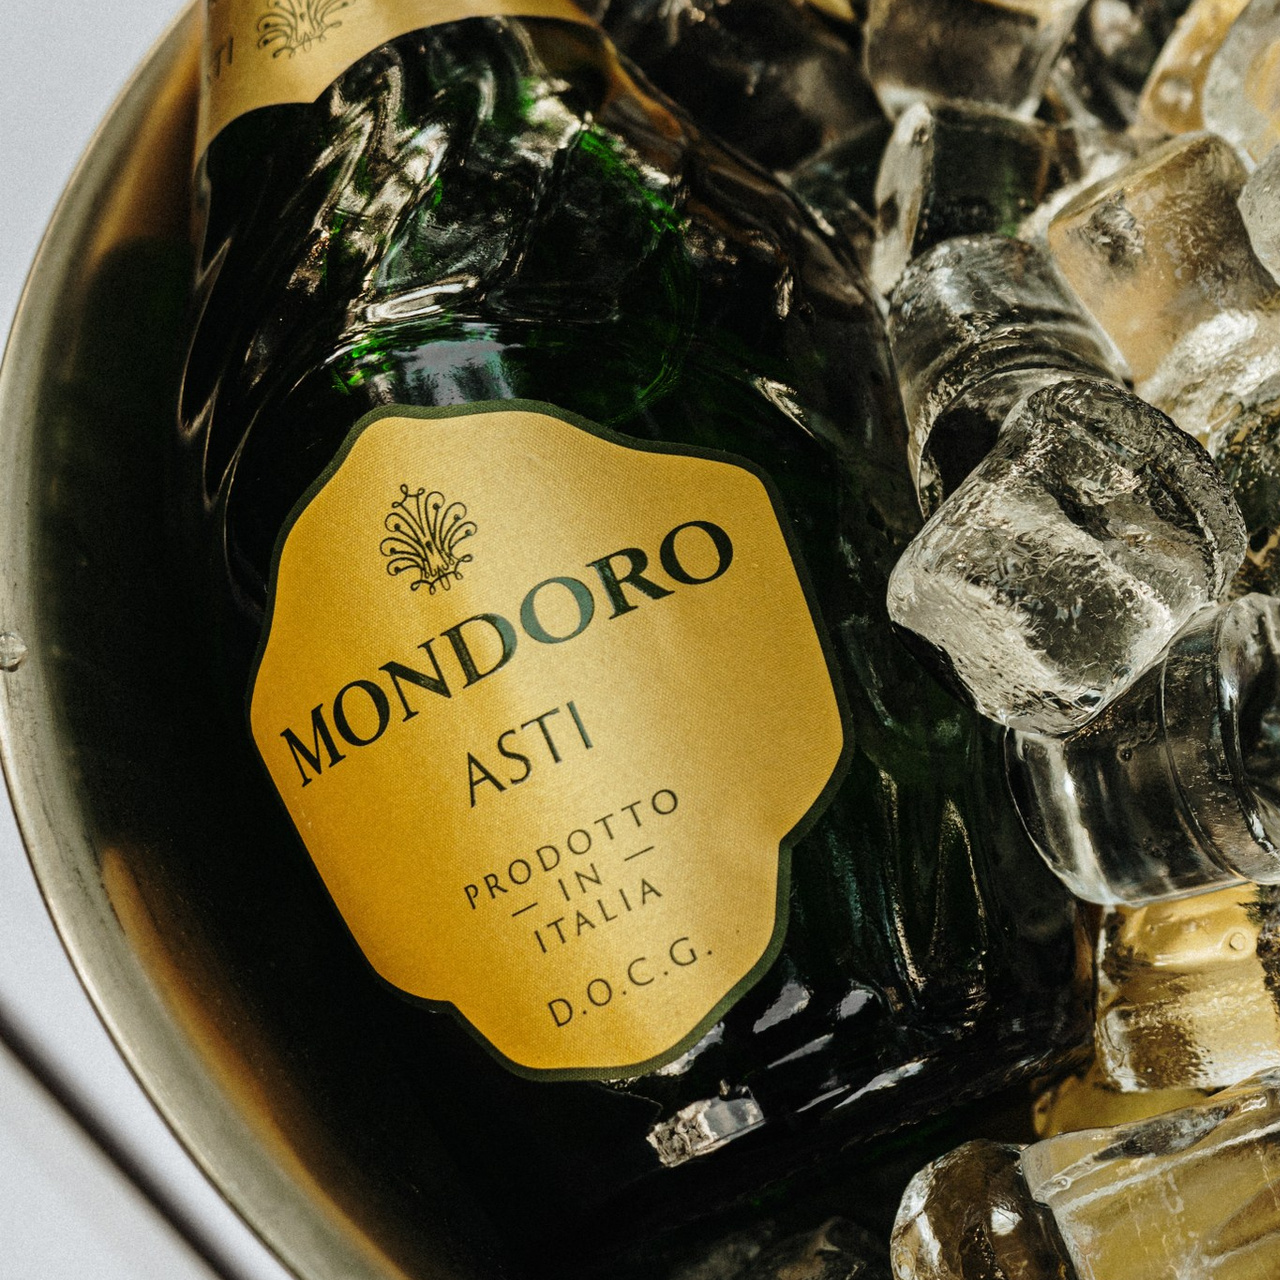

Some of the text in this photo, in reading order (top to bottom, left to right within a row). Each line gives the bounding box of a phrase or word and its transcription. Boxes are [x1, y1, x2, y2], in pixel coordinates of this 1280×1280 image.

[280, 521, 734, 787] MONDORO
[465, 700, 594, 807] ASTI
[463, 788, 680, 909] PRODOTTO
[534, 878, 663, 953] ITALIA
[547, 935, 713, 1027] D.O.C.G.
